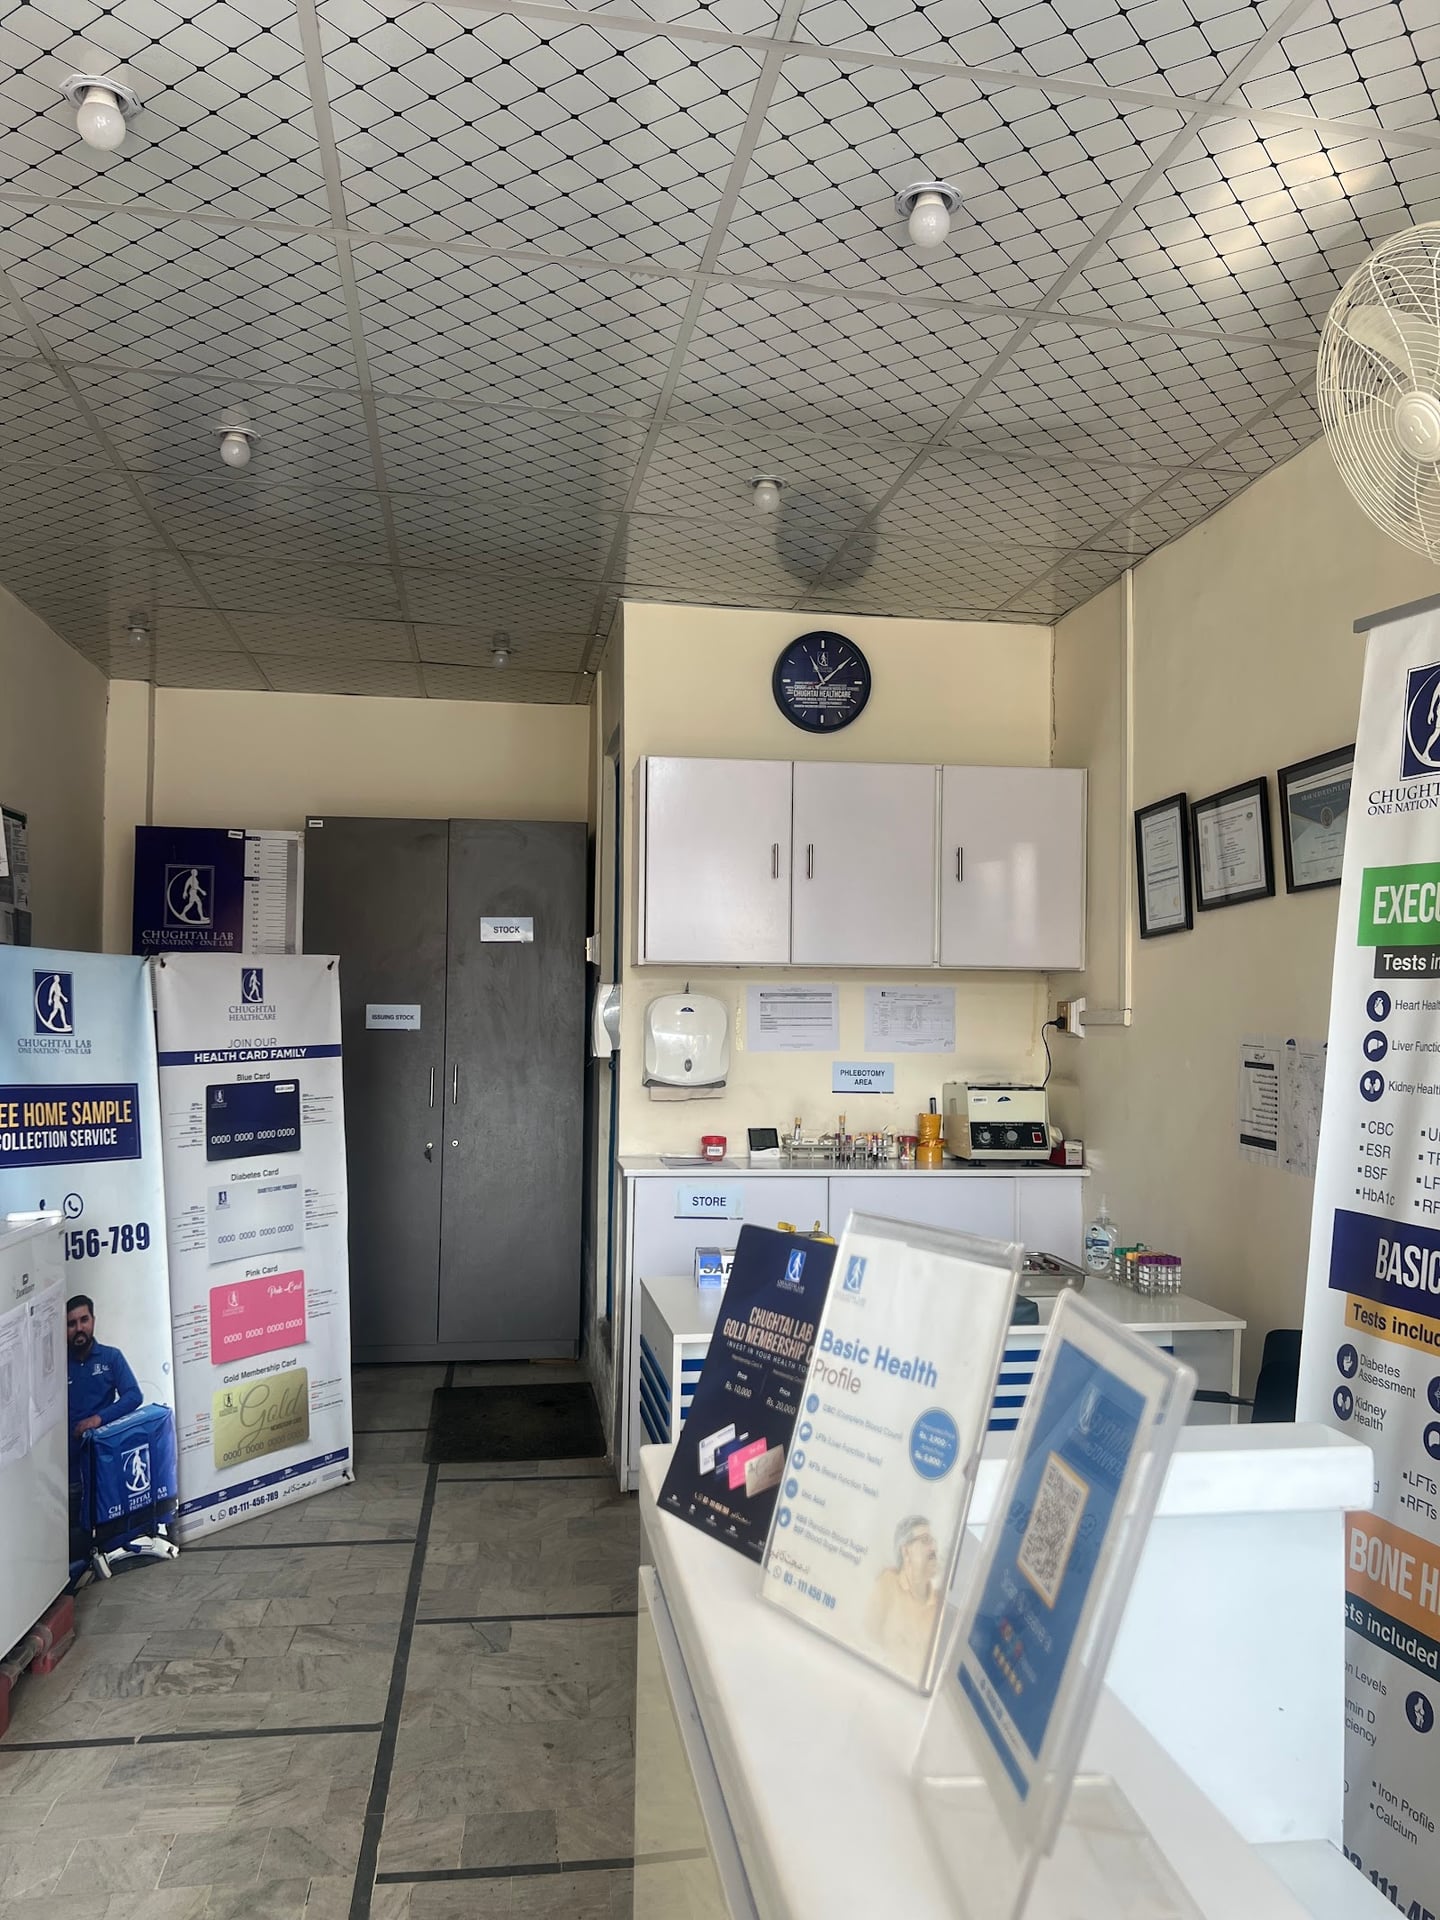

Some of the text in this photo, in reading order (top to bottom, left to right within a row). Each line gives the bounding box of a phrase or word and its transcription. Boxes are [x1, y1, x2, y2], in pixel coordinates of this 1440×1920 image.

[1368, 798, 1438, 815] ONE NATION
[142, 930, 234, 941] CHUGHTAI LAB
[493, 926, 520, 934] STOCK
[1383, 954, 1427, 971] Tests
[228, 1005, 276, 1014] CHUGHTAI
[1395, 999, 1421, 1011] Heart
[229, 1013, 276, 1021] HEALTHCARE
[17, 1038, 92, 1048] CHUGHTAI LAB
[228, 1037, 277, 1048] JOIN OUR
[1392, 1040, 1414, 1052] Liver
[194, 1048, 307, 1063] HEALTH CARD FAMILY
[237, 1072, 271, 1082] Blue Card
[840, 1069, 886, 1077] PHLEBOTOMY
[854, 1078, 873, 1086] AREA
[1388, 1080, 1416, 1095] Kidney
[23, 1102, 68, 1127] HOME
[71, 1100, 132, 1125] SAMPLE
[70, 1128, 118, 1147] SERVICE
[1368, 1120, 1395, 1137] CBC
[1366, 1143, 1392, 1159] ESR
[231, 1168, 280, 1182] Diabetes Card
[1364, 1165, 1388, 1182] BSF
[692, 1196, 727, 1207] STORE
[1362, 1187, 1396, 1206] HbA1c
[246, 1265, 278, 1278] Pink Card
[749, 1306, 814, 1341] CHUGHTAI LAB
[1353, 1302, 1387, 1331] Tests
[723, 1318, 747, 1341] GOLD
[745, 1325, 806, 1360] MEMBERSHIP
[756, 1349, 771, 1361] YOUR
[773, 1355, 796, 1369] HEALTH
[820, 1328, 938, 1389] Basic Health
[1360, 1353, 1401, 1378] Diabetes
[223, 1358, 297, 1384] Gold Membership Card
[812, 1358, 862, 1394] Profile
[1359, 1367, 1417, 1399] Assessment
[1355, 1395, 1387, 1420] Kidney
[1354, 1410, 1384, 1432] Health
[1408, 1470, 1438, 1496] LFTs
[228, 1490, 279, 1517] 03-111-456-789
[1406, 1493, 1438, 1521] RFTs
[1349, 1527, 1417, 1601] BONE
[1367, 1612, 1438, 1670] included
[1355, 1665, 1388, 1696] Levels
[1367, 1710, 1376, 1724] D
[1378, 1783, 1435, 1833] Iron Profile
[1375, 1804, 1418, 1845] Calcium
